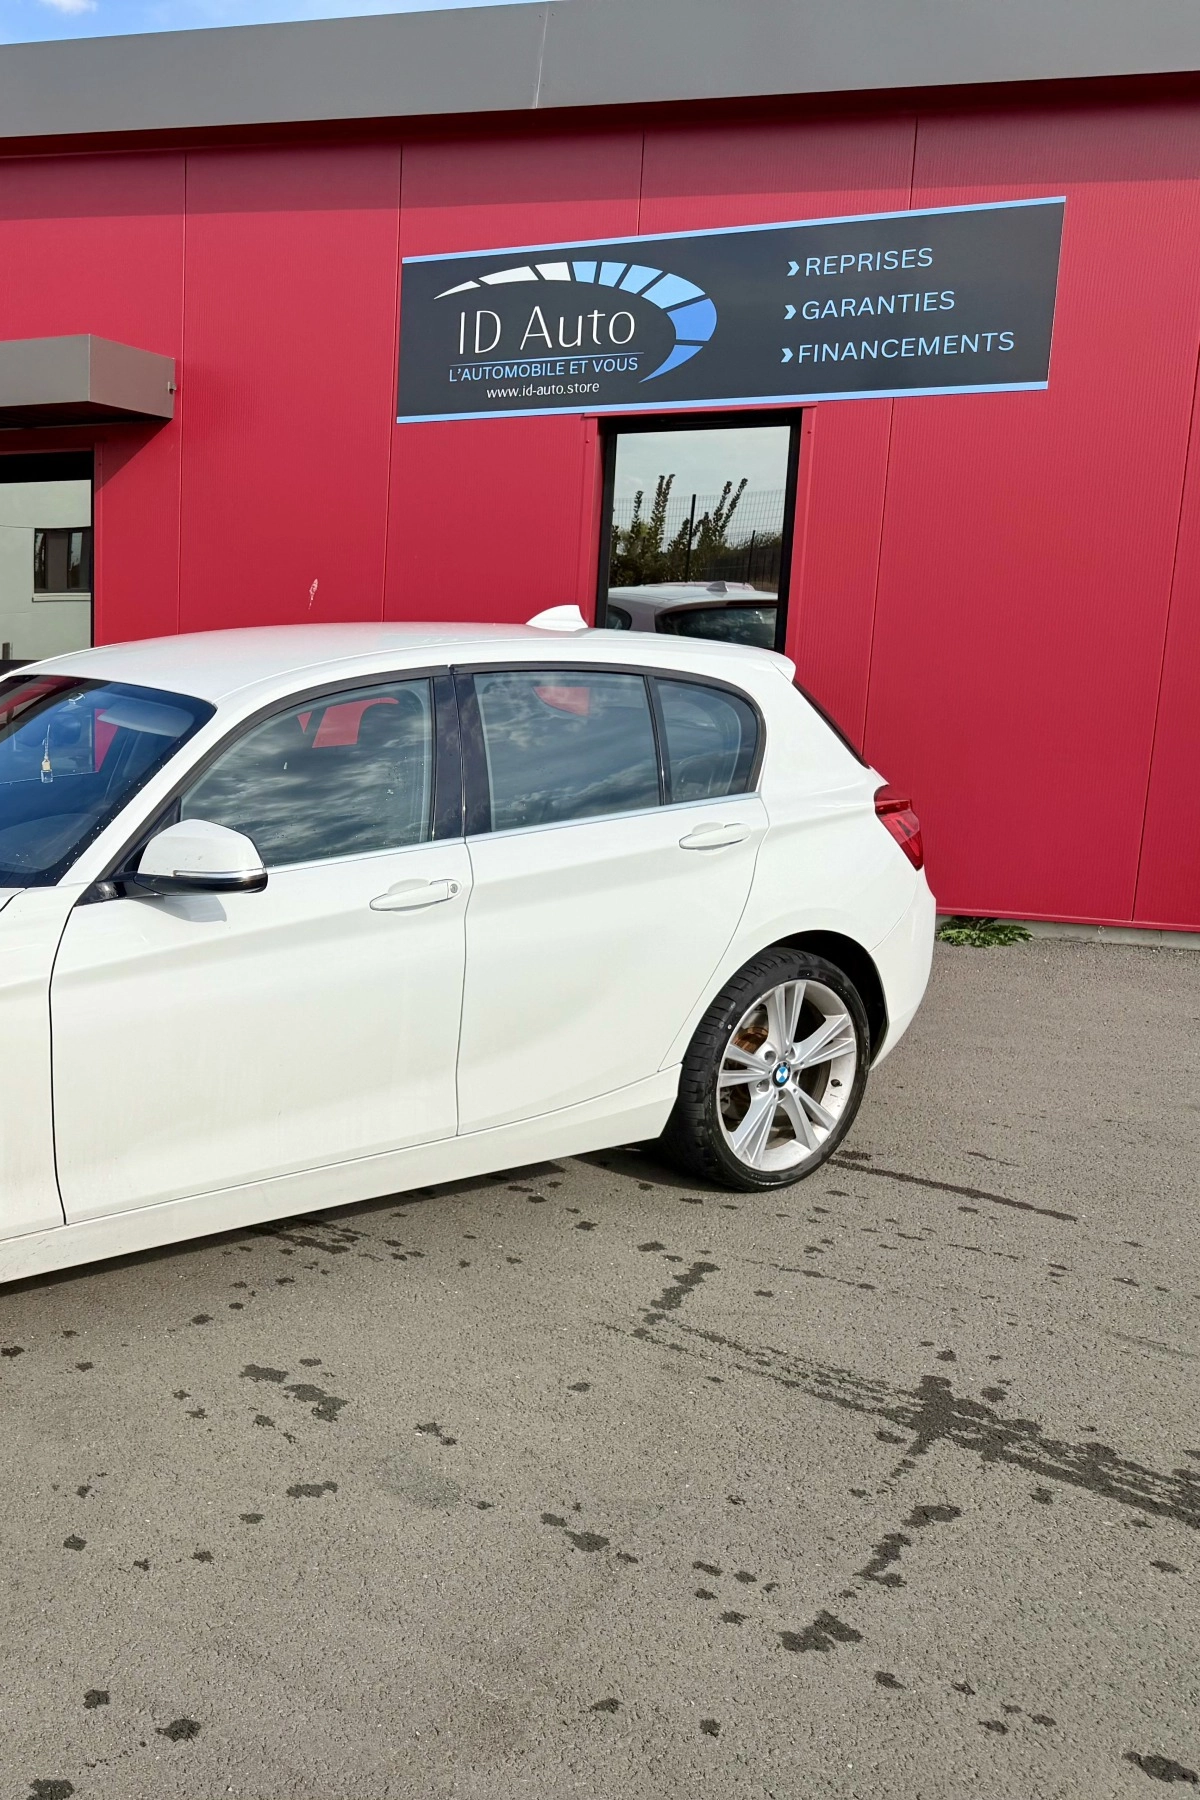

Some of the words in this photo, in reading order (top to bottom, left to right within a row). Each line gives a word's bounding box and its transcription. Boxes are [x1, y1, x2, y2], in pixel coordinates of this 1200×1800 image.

[805, 247, 933, 277] REPRISES
[802, 290, 956, 320] GARANTIES
[459, 310, 502, 355] ID
[519, 305, 636, 351] Auto
[798, 331, 1015, 364] FINANCEMENTS
[449, 361, 565, 382] L'AUTOMOBILE
[569, 360, 588, 375] ET
[592, 357, 639, 373] VOUS
[486, 382, 600, 399] www.id-auto.store
